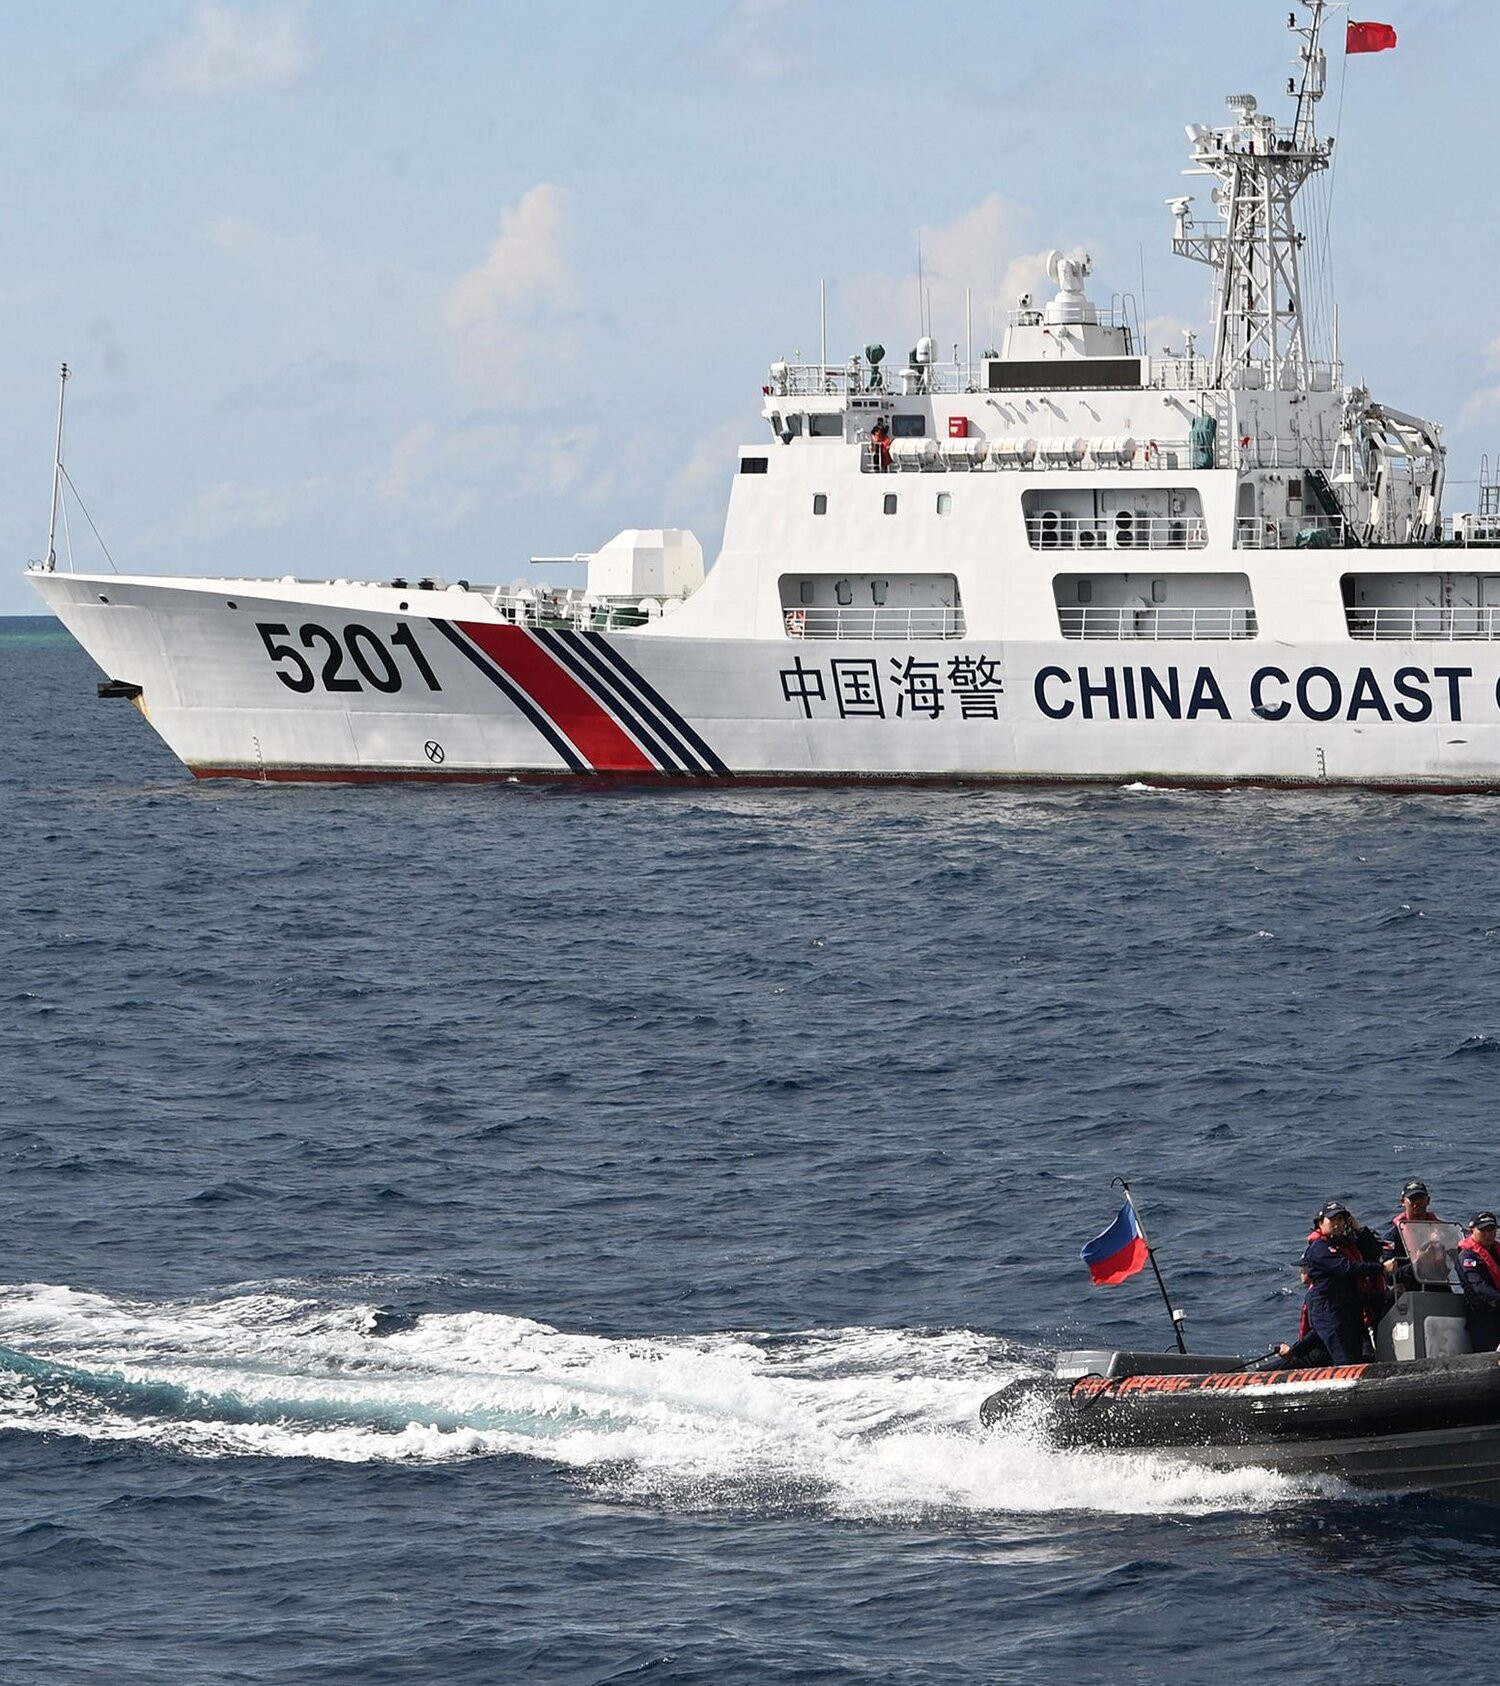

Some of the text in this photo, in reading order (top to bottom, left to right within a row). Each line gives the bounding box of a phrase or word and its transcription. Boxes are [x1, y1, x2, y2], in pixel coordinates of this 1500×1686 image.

[255, 622, 442, 694] 5201
[779, 655, 1004, 720] 中国海警
[1033, 665, 1232, 720] CHINA
[1251, 666, 1472, 722] COAST
